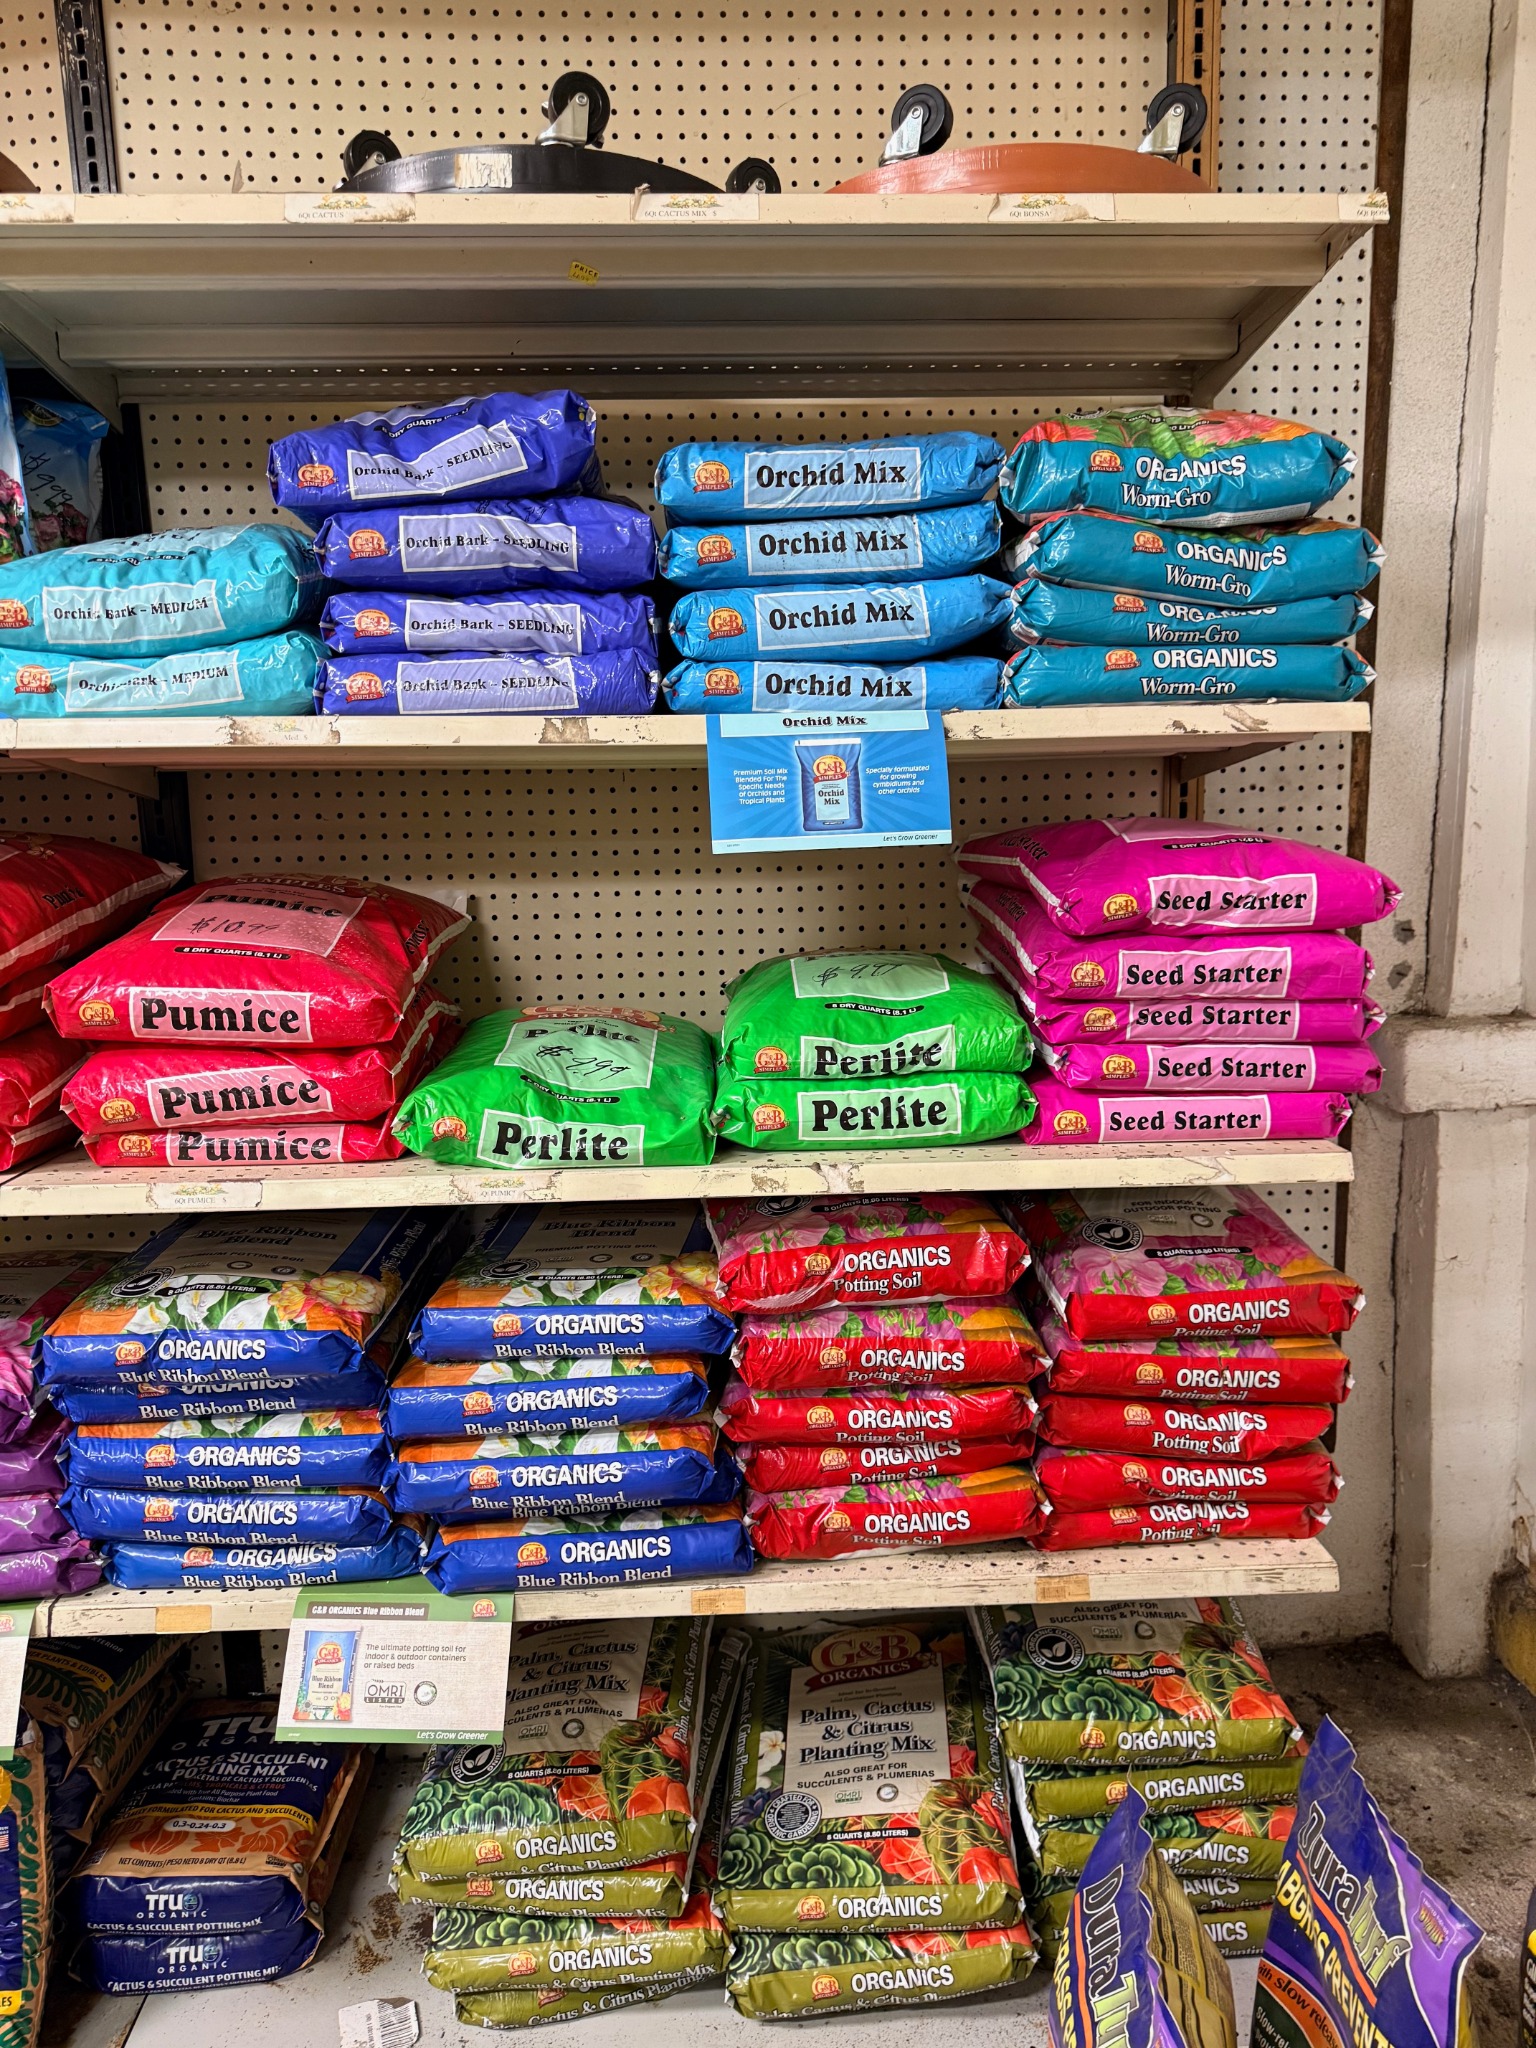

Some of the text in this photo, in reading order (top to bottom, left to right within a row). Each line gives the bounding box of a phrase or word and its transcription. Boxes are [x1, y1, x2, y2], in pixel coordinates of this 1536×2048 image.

[354, 441, 513, 480] Orchid Bark SEEDLING
[1136, 455, 1248, 482] ORGANICS
[696, 467, 727, 484] G&B
[756, 462, 907, 488] Orchid Mix
[698, 483, 726, 491] SIMPLES
[1121, 484, 1211, 509] Worm-Gro
[406, 534, 569, 553] Orchid Bark SEEDLING
[759, 531, 908, 556] Orchid Mix
[1177, 542, 1287, 572] ORGANICS
[1164, 565, 1251, 596] Worm-Gro
[151, 597, 208, 615] MEDIUM
[1147, 624, 1239, 643] Worm-Gro
[1152, 649, 1278, 668] ORGANICS
[172, 667, 229, 685] MEDIUM
[765, 674, 913, 698] Orchid Mix
[1141, 678, 1236, 695] Worm-Gro
[782, 716, 867, 727] Orchid Mix
[816, 761, 842, 775] G&B
[818, 789, 844, 797] Orchid
[1107, 898, 1136, 913] G&B
[1157, 890, 1308, 911] Seed Starter
[1107, 912, 1133, 921] SIMPLES
[253, 950, 271, 958] (8.1
[1126, 965, 1283, 985] Seed Starter
[140, 998, 301, 1034] Pumice
[814, 1041, 942, 1075] Perlite
[159, 1076, 322, 1120] Pumice
[811, 1096, 947, 1132] Perlite
[1109, 1111, 1262, 1131] Seed Starter
[177, 1130, 332, 1162] Pumice
[491, 1121, 630, 1162] Perlite
[844, 1246, 951, 1273] ORGANICS
[834, 1274, 922, 1294] Potting Soil
[1189, 1299, 1290, 1323] ORGANICS
[535, 1314, 644, 1335] ORGANICS
[157, 1339, 266, 1361] ORGANICS
[139, 1398, 296, 1419] Blue Ribbon Blend
[1165, 1410, 1267, 1431] ORGANICS
[1152, 1432, 1241, 1454] Potting Soil
[226, 1543, 337, 1567] ORGANICS
[561, 1536, 671, 1562] ORGANICS
[517, 1567, 672, 1588] Blue Ribbon Blend
[312, 1606, 424, 1616] G&B ORGANICS Blue Ribbon Blend
[366, 1644, 379, 1652] The
[381, 1644, 411, 1652] ultimate
[413, 1644, 440, 1653] potting
[397, 1653, 427, 1661] outdoor
[368, 1684, 403, 1697] OMRI
[799, 1700, 934, 1724] Palm, Cactus
[417, 1731, 434, 1739] Let's
[457, 1732, 488, 1740] Greener
[822, 1719, 912, 1741] & Citrus
[799, 1735, 936, 1764] Planting Mix
[797, 1777, 863, 1788] SUCCULENTS
[877, 1770, 935, 1780] PLUMERIAS
[824, 1768, 850, 1778] ALSO
[854, 1764, 885, 1773] GREAT
[1144, 1773, 1246, 1800] ORGANICS
[172, 1821, 227, 1829] 0.3-0.24-0.3
[833, 1832, 862, 1840] QUARTS
[882, 1829, 909, 1837] LITERS)
[515, 1830, 617, 1860] ORGANICS
[137, 1910, 207, 1919] ORGANIC
[837, 1894, 943, 1919] ORGANICS
[87, 1922, 125, 1931] CACTUS
[137, 1923, 195, 1931] SUCCULENT
[196, 1922, 240, 1931] POTTING
[243, 1917, 262, 1929] MIX
[1274, 1974, 1309, 2012] slow
